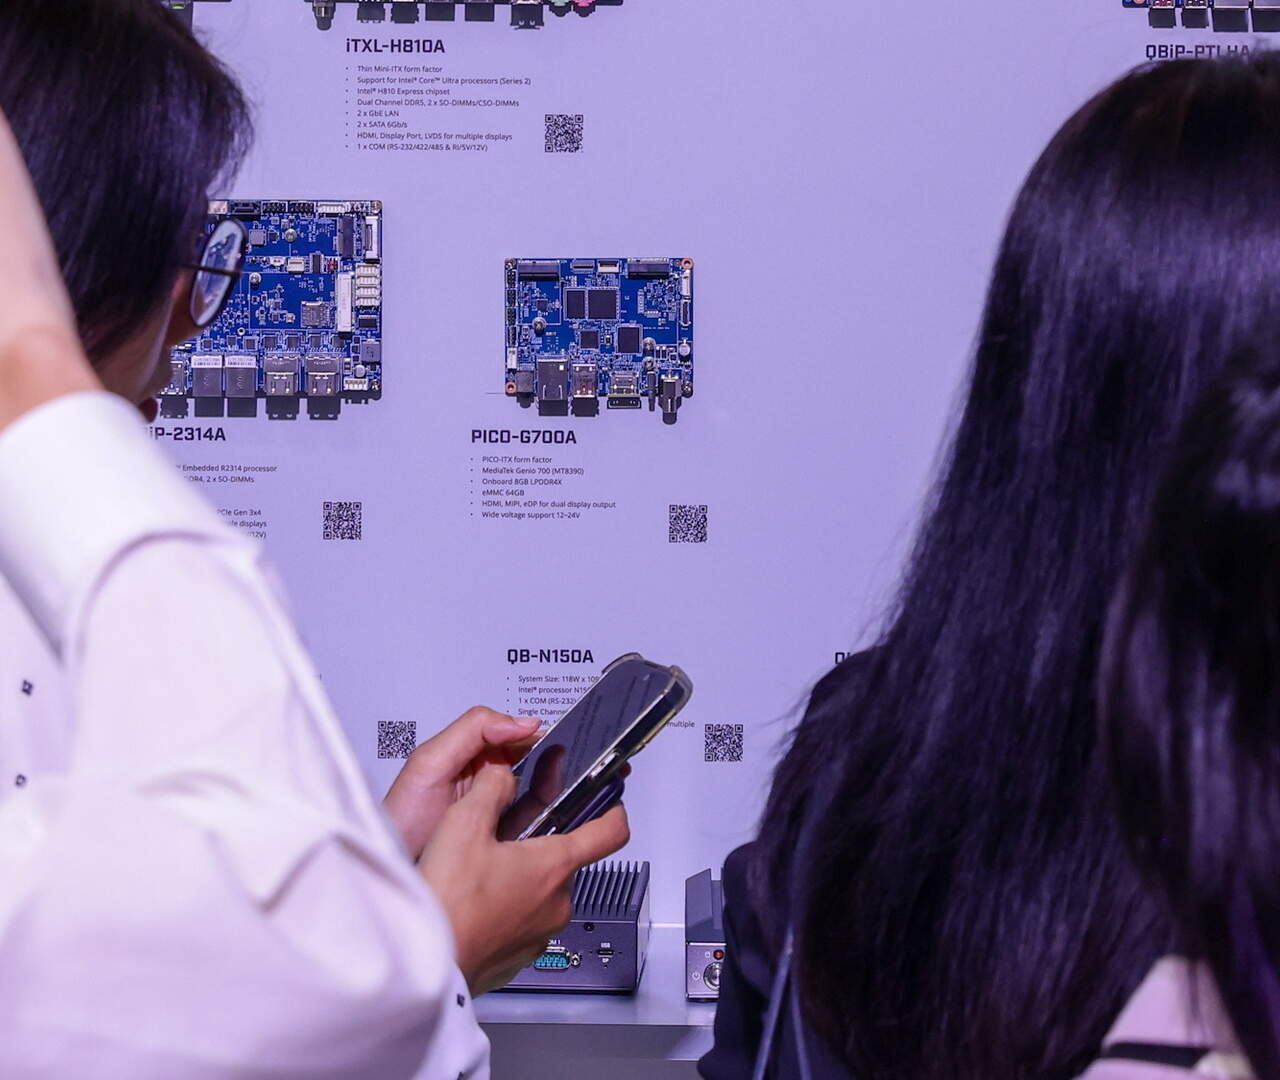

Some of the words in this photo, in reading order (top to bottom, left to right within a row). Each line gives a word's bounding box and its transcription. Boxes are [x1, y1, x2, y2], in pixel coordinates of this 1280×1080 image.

[347, 39, 445, 53] iTXL-H810A
[357, 64, 373, 72] Thin
[374, 64, 402, 72] Mini-ITX
[403, 65, 421, 73] form
[422, 65, 443, 73] factor
[397, 88, 424, 96] Express
[425, 88, 450, 96] chipset
[149, 426, 226, 441] iP-2314A
[472, 430, 576, 443] PICO-G700A
[482, 455, 512, 463] PICO-ITX
[513, 455, 531, 463] form
[532, 455, 553, 463] factor
[182, 464, 219, 472] Embedded
[243, 466, 277, 474] processor
[482, 466, 515, 474] MediaTek
[516, 466, 536, 474] Genio
[482, 510, 500, 518] Wide
[501, 511, 526, 519] voltage
[527, 512, 554, 520] support
[239, 520, 267, 528] displays
[508, 649, 593, 664] QB-N150A
[519, 675, 543, 683] System
[544, 675, 559, 683] Size:
[538, 687, 572, 695] processor
[518, 708, 539, 716] Single
